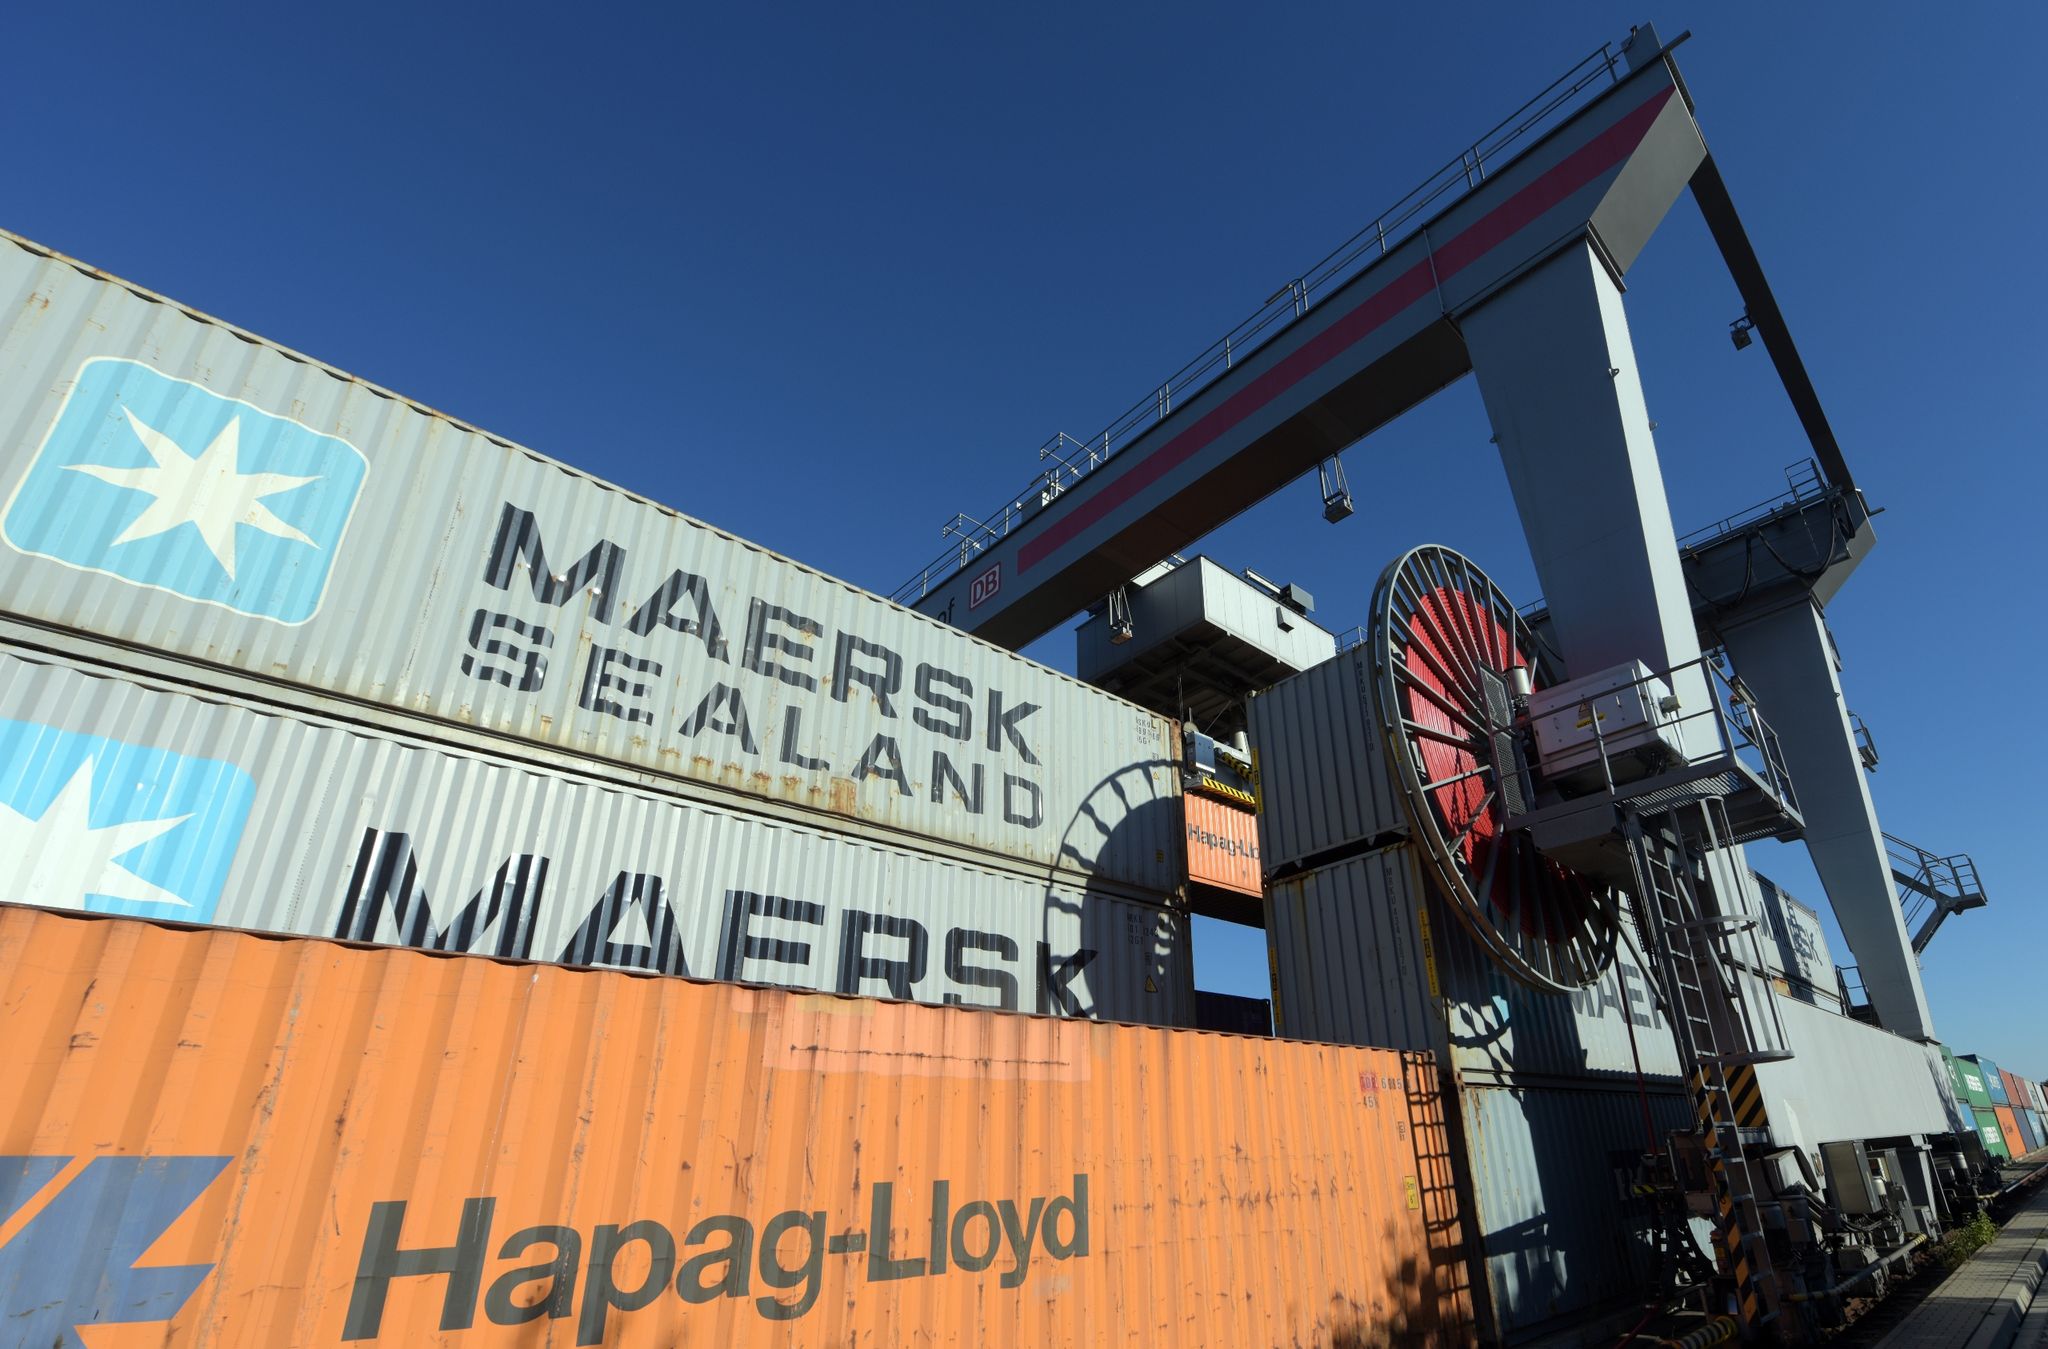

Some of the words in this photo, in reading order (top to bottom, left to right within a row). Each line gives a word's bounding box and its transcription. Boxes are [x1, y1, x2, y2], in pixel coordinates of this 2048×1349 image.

[483, 501, 1043, 767] MAERSK
[972, 567, 999, 607] DB
[461, 607, 1044, 830] SEALAND
[333, 826, 1099, 1018] MAERSK
[1188, 823, 1259, 860] Hapag-Llo
[341, 1173, 1089, 1347] Hapag-Lloyd
